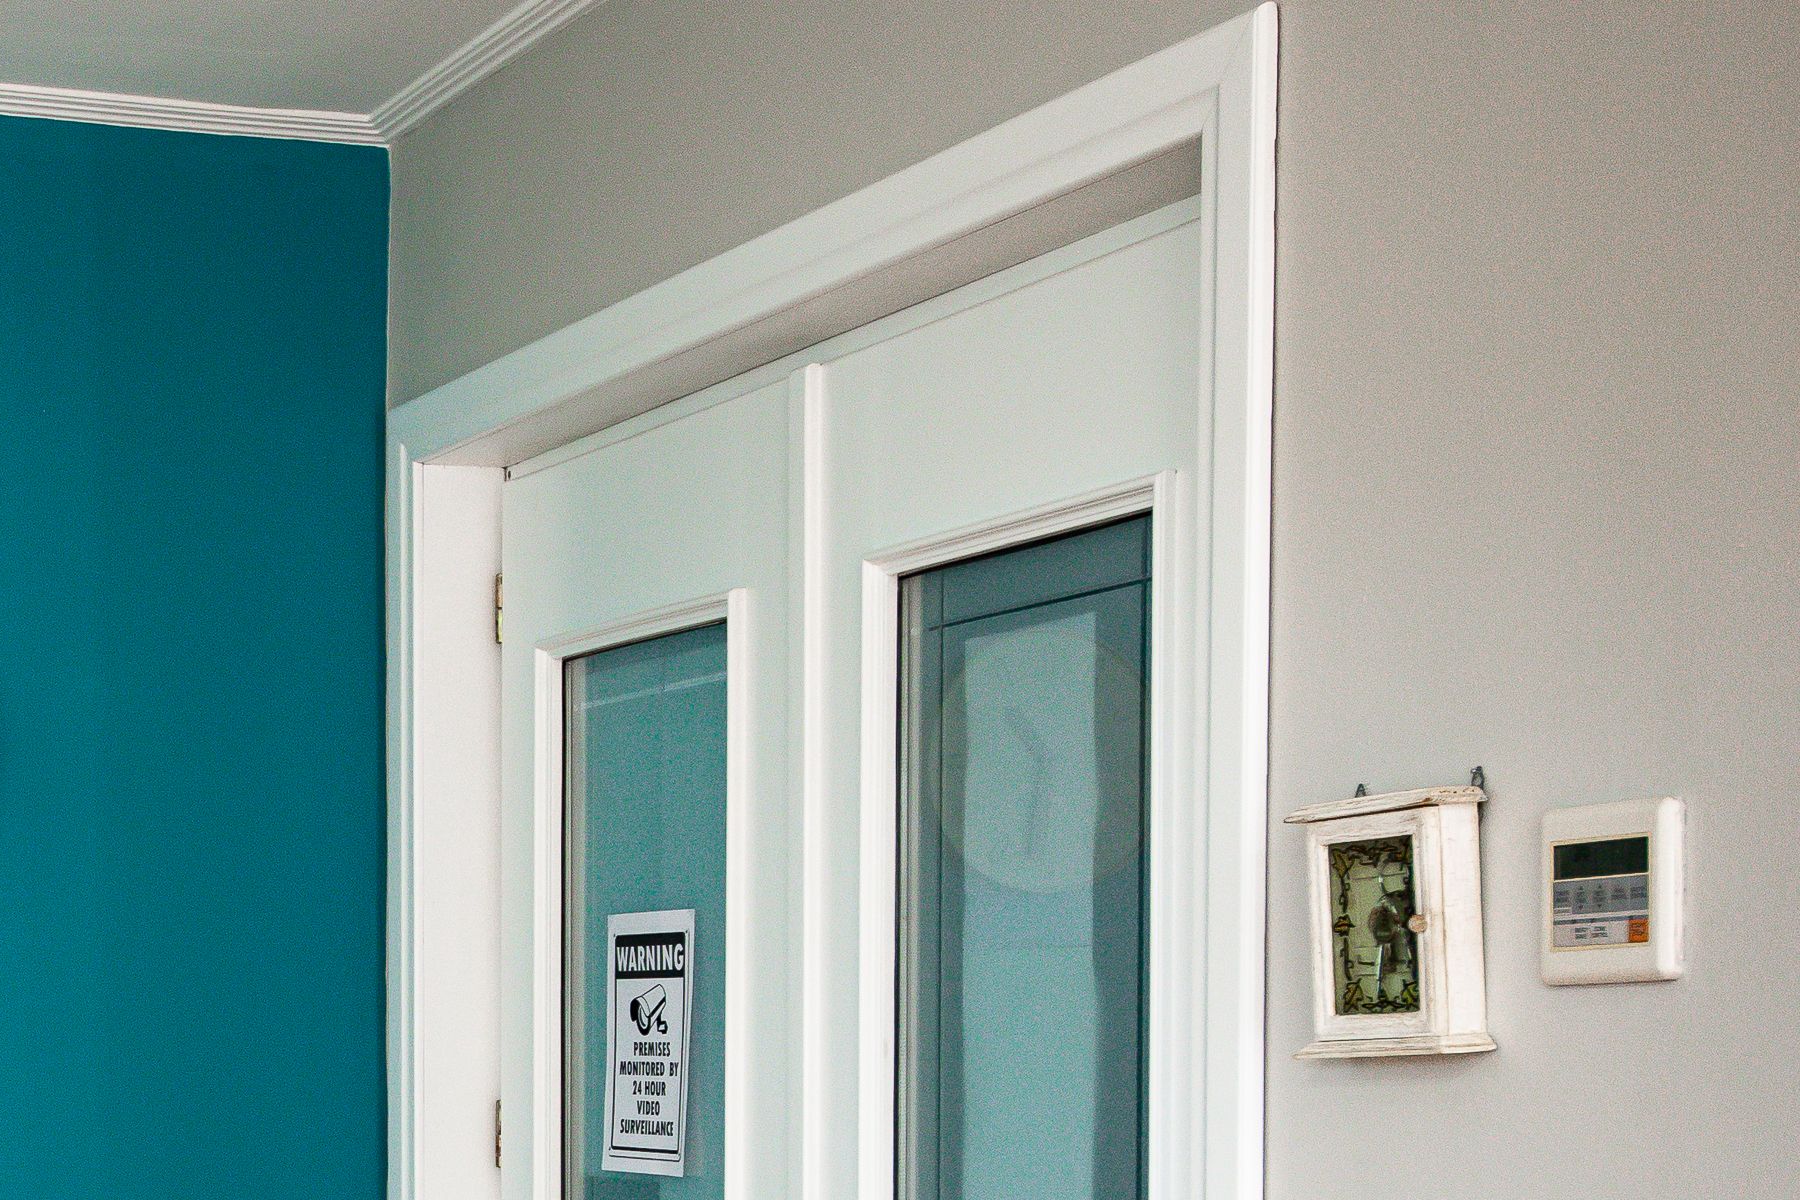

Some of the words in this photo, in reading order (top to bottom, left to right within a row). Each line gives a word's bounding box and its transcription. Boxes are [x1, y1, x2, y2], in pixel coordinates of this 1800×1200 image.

[616, 943, 684, 972] WARNING
[633, 1041, 671, 1057] PREMISES
[619, 1060, 665, 1076] MONITORED
[669, 1061, 679, 1077] BY
[632, 1080, 642, 1095] 24
[644, 1080, 667, 1096] HOUR
[636, 1100, 661, 1116] VIDEO
[619, 1118, 674, 1137] SURVEILLANCE
